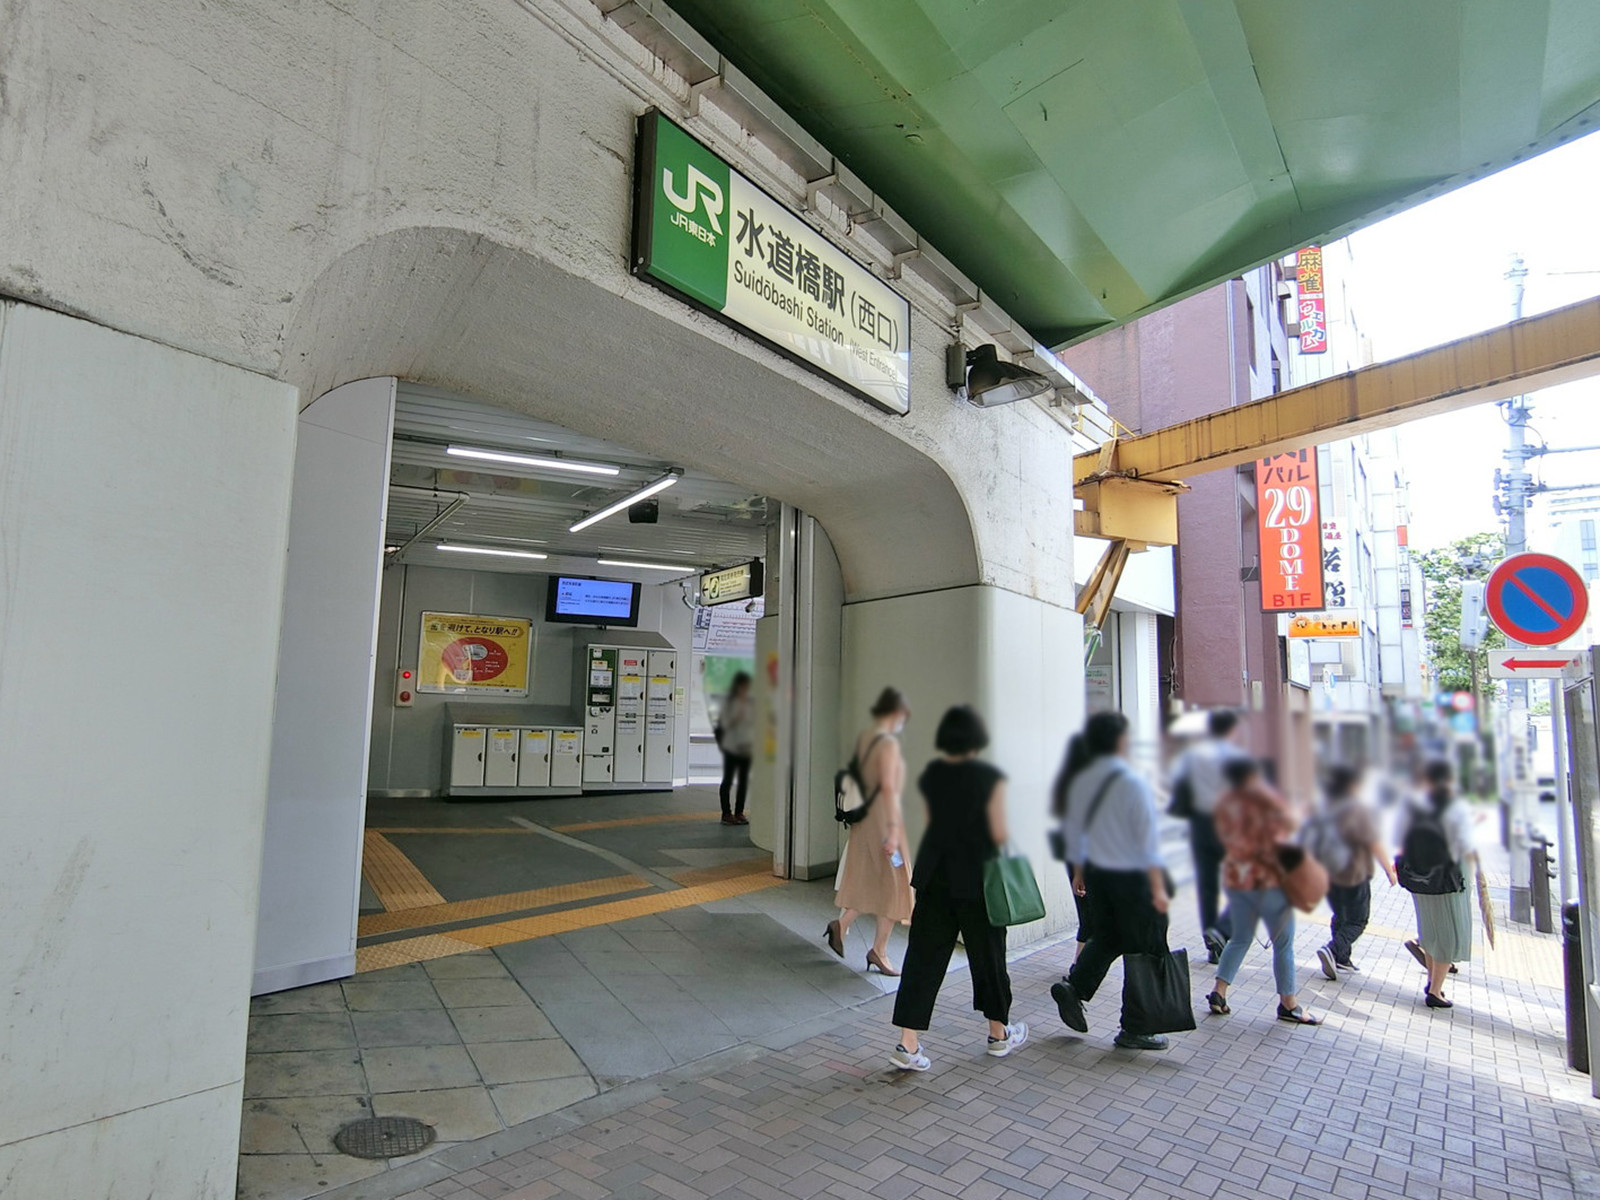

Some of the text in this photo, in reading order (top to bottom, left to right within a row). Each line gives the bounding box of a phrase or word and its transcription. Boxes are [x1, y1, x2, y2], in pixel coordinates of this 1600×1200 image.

[662, 163, 724, 236] JR
[670, 211, 717, 247] JR東日本
[1297, 249, 1322, 292] 麻雀
[734, 260, 803, 321] Suidōbashi
[807, 306, 844, 347] Station
[1300, 301, 1324, 349] ウェルカム
[1264, 464, 1310, 484] バル
[1265, 485, 1313, 528] 29
[1279, 527, 1304, 591] DOME
[1273, 592, 1312, 607] B1F
